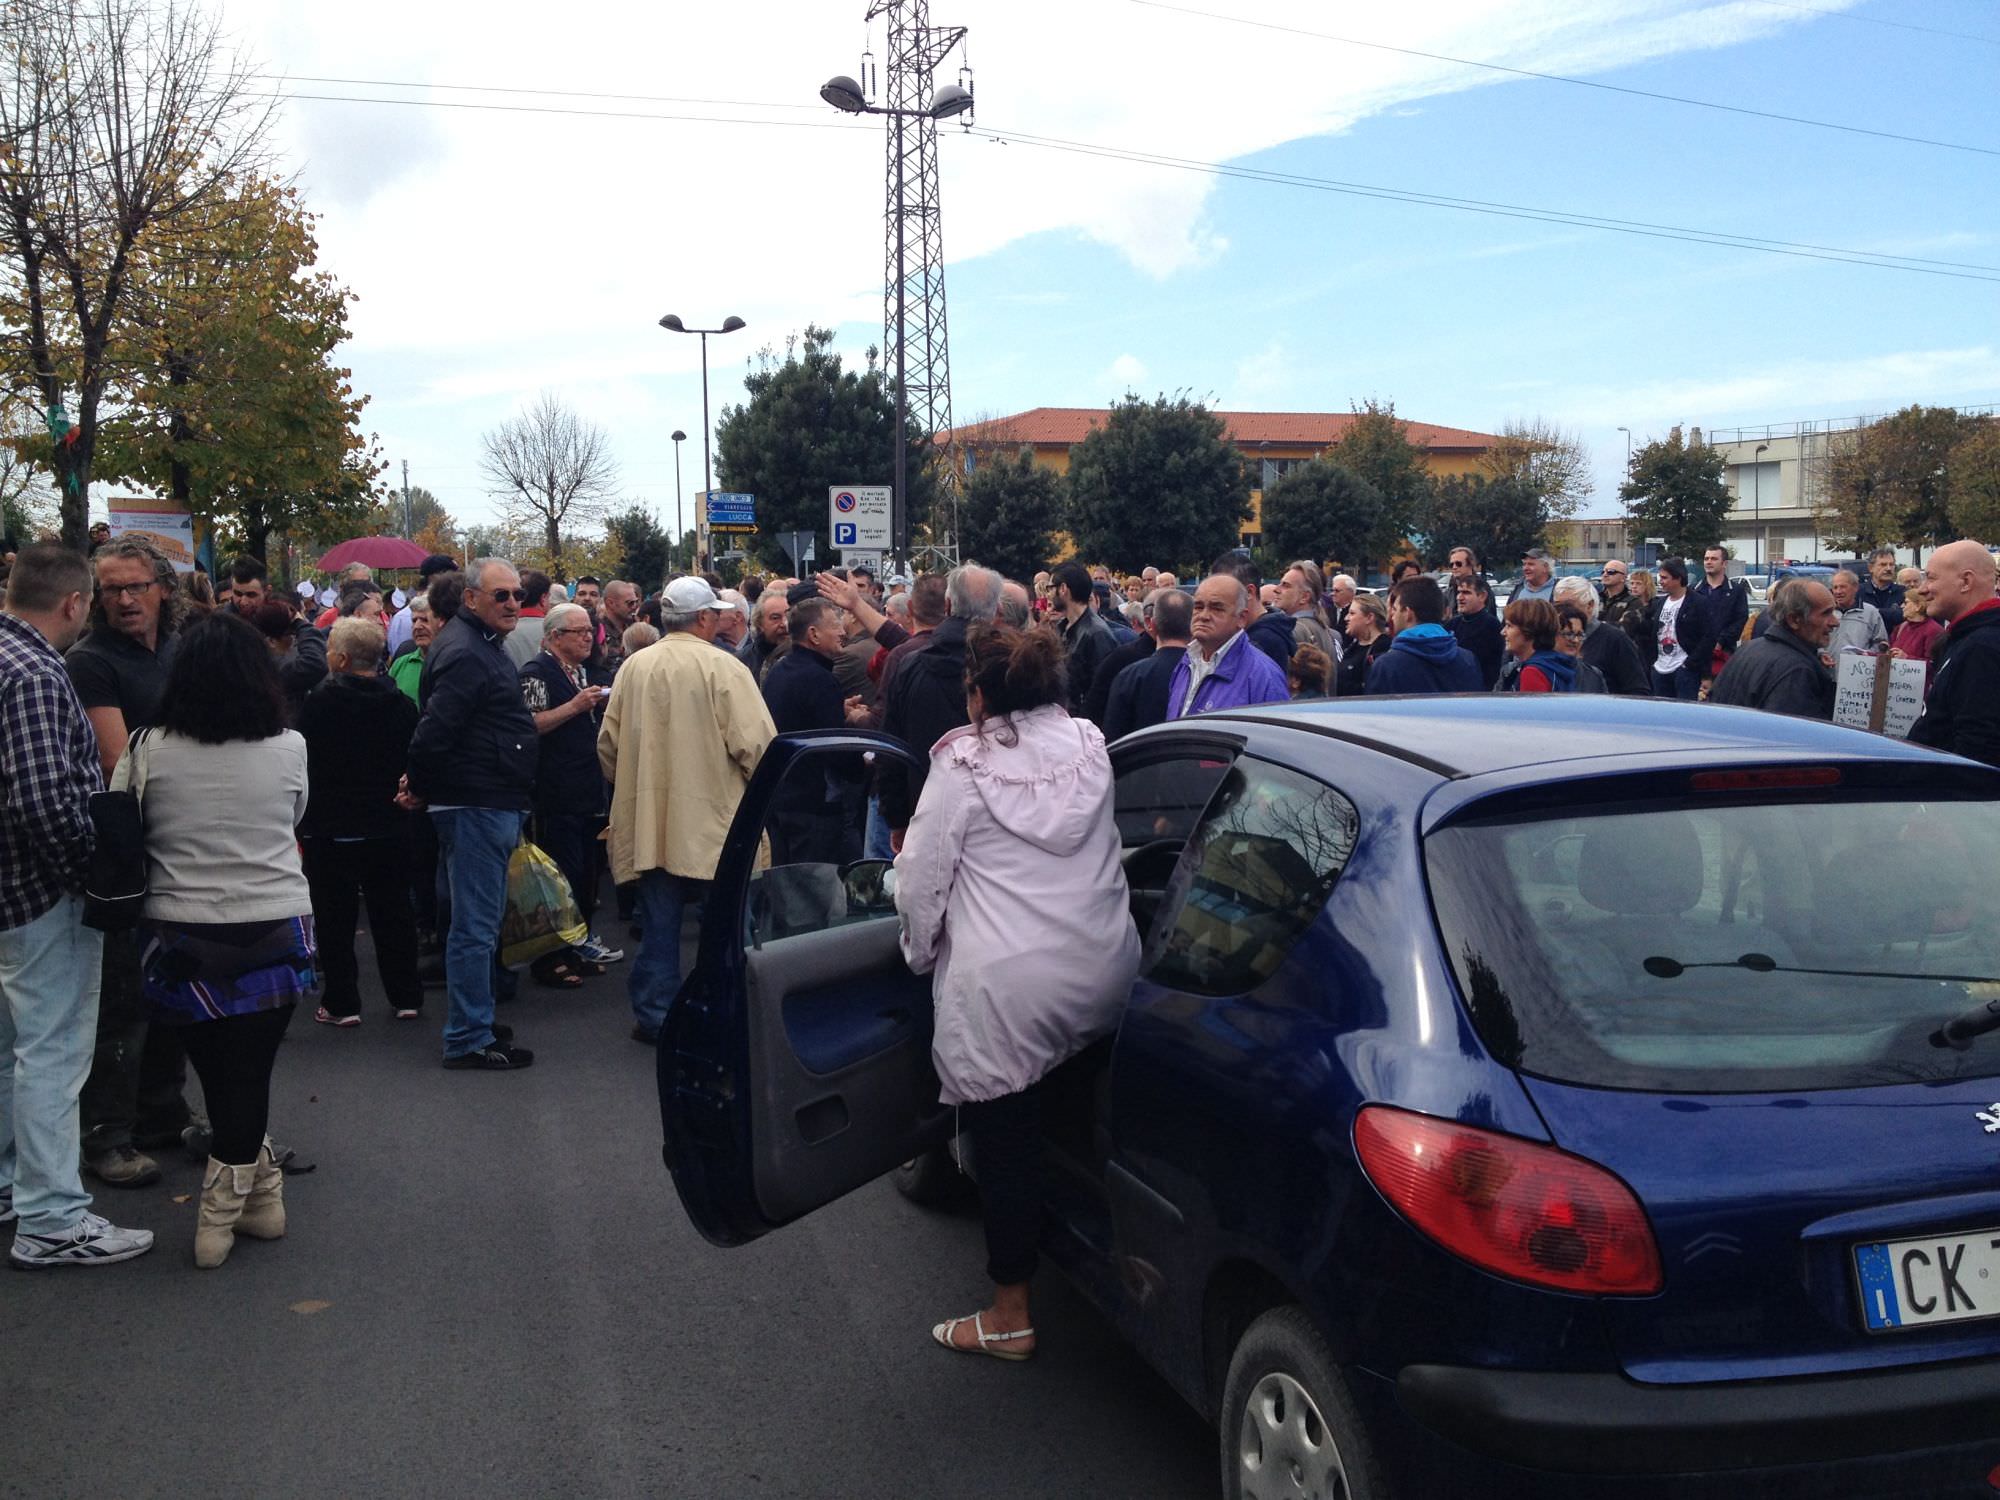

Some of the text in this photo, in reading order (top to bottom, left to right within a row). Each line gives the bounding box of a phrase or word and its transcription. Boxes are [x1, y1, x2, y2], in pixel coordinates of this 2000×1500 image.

[728, 513, 753, 521] LUCCA
[839, 525, 852, 542] P
[1901, 1243, 1977, 1315] CK
